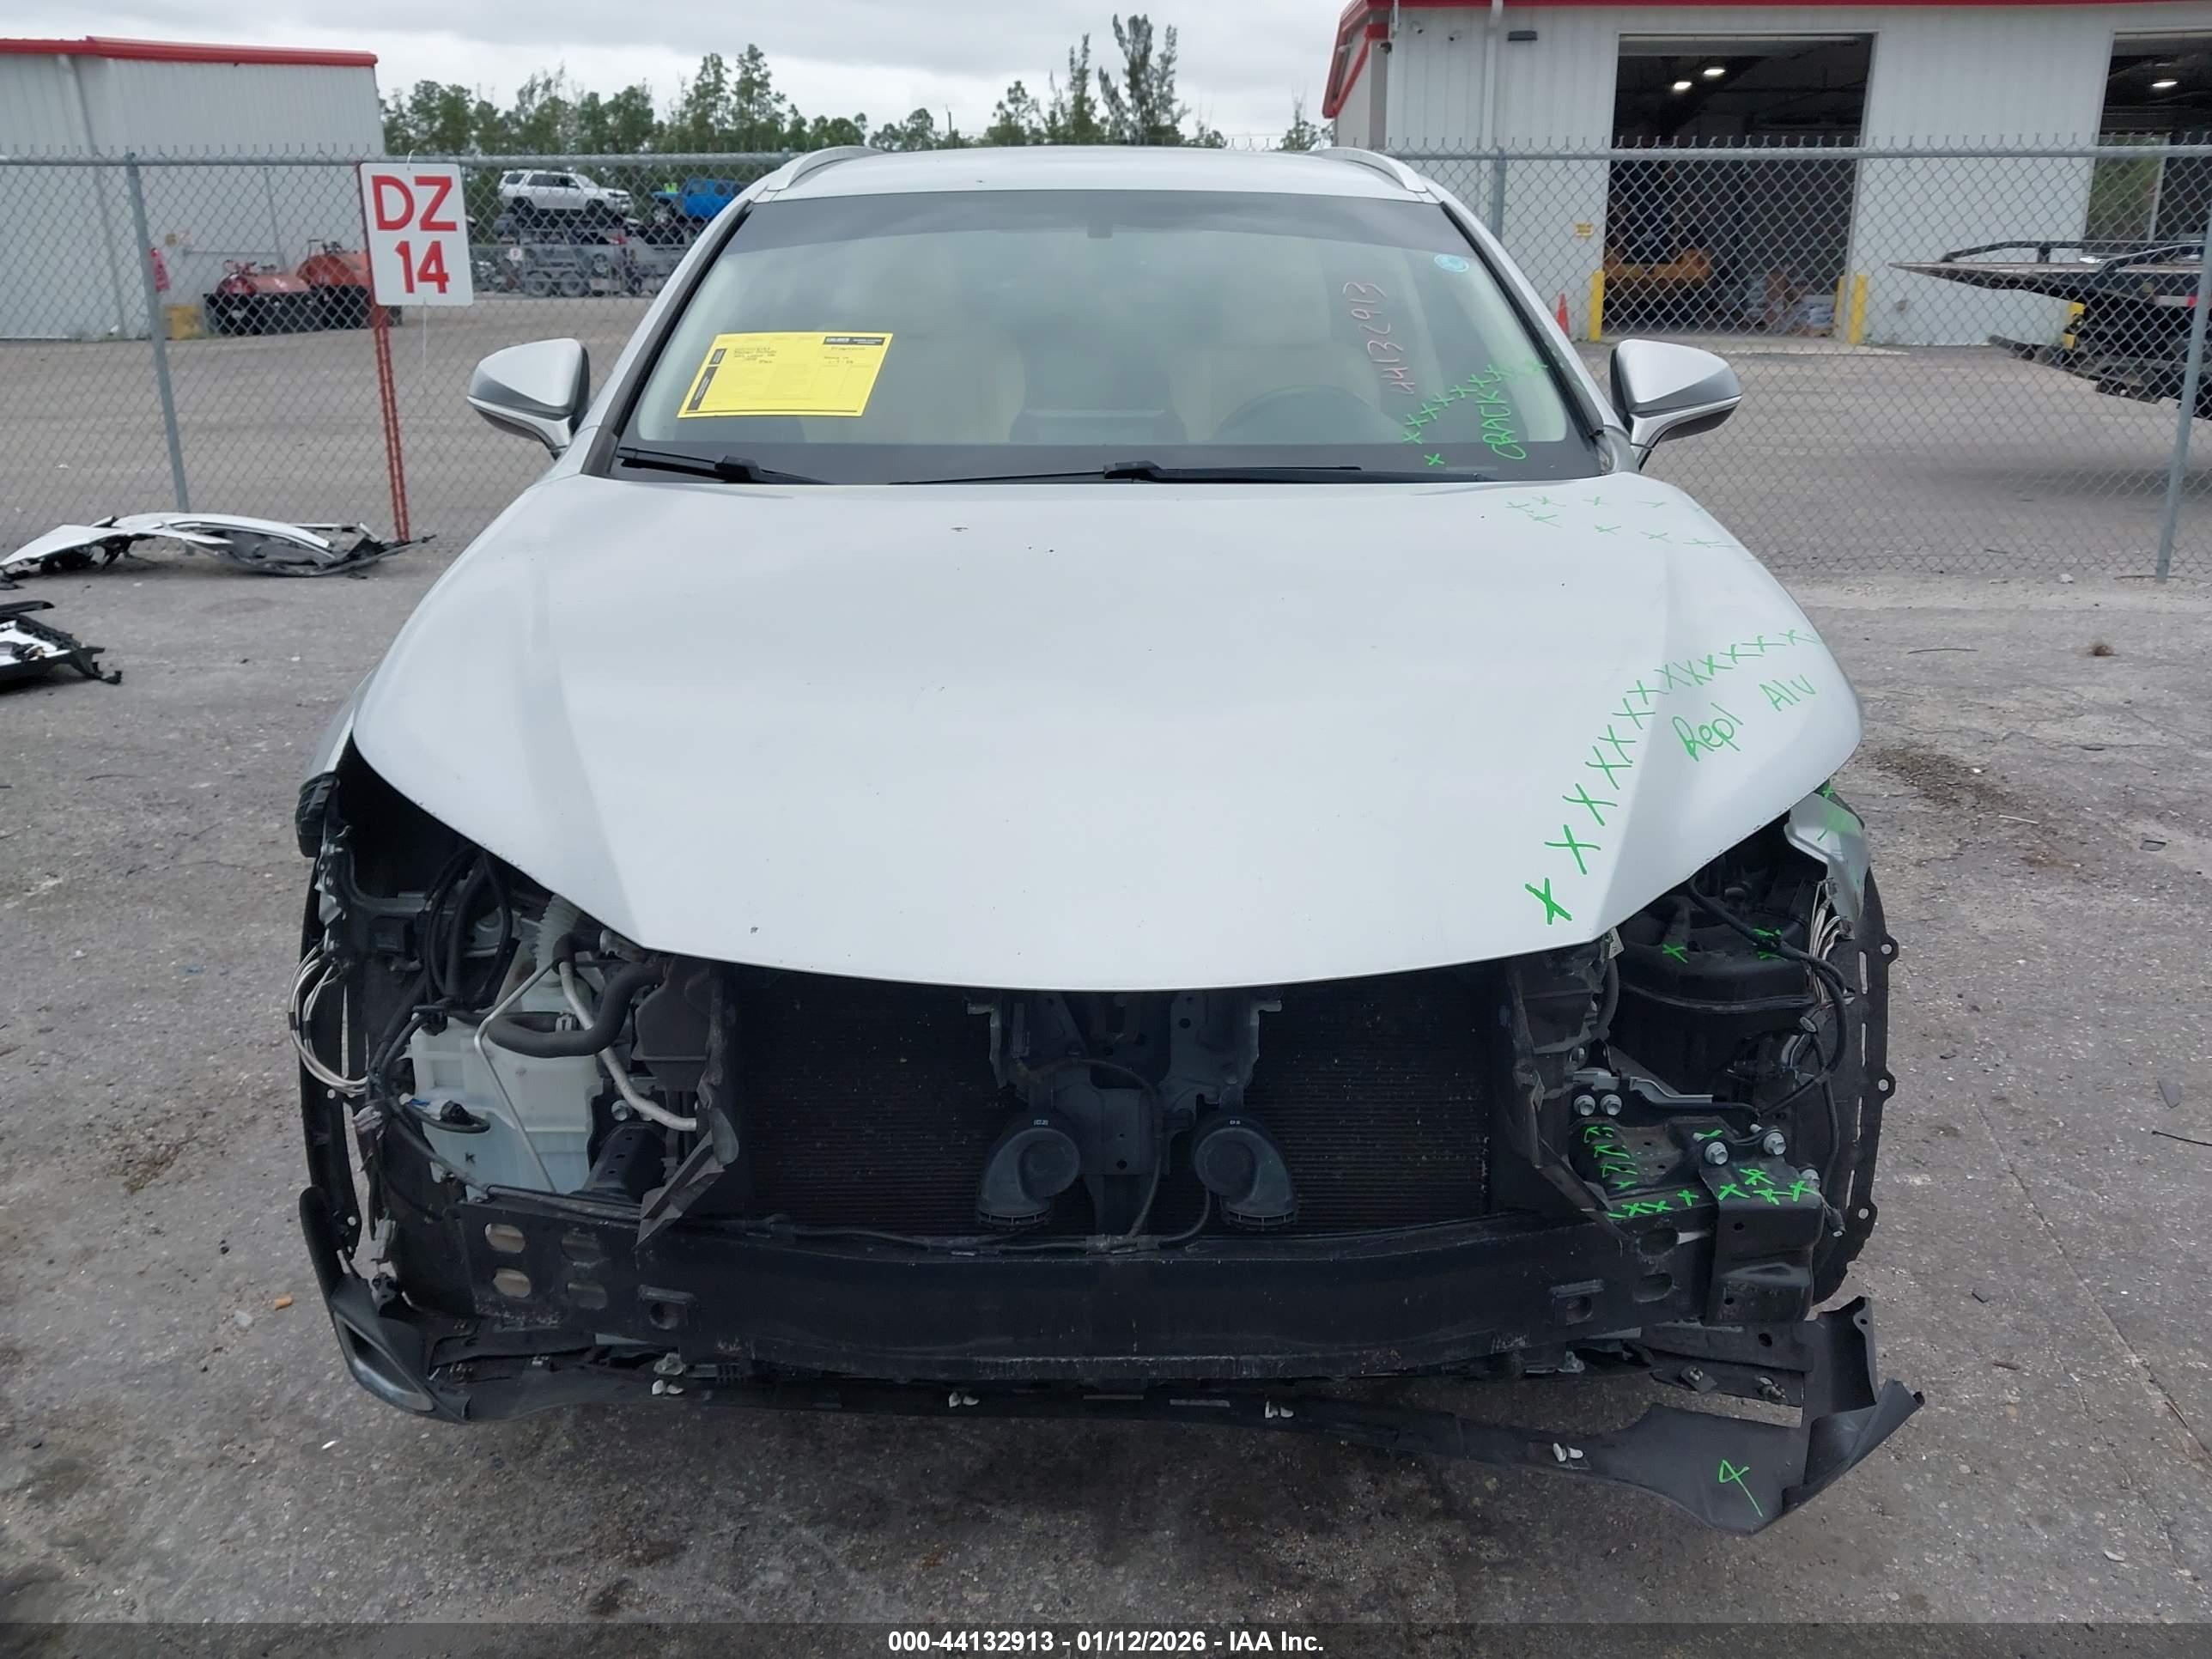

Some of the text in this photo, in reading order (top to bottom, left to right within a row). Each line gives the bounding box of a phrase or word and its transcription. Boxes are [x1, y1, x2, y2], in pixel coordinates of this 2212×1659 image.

[372, 175, 458, 231] DZ
[395, 240, 451, 294] 14
[1475, 389, 1527, 460] CRACK
